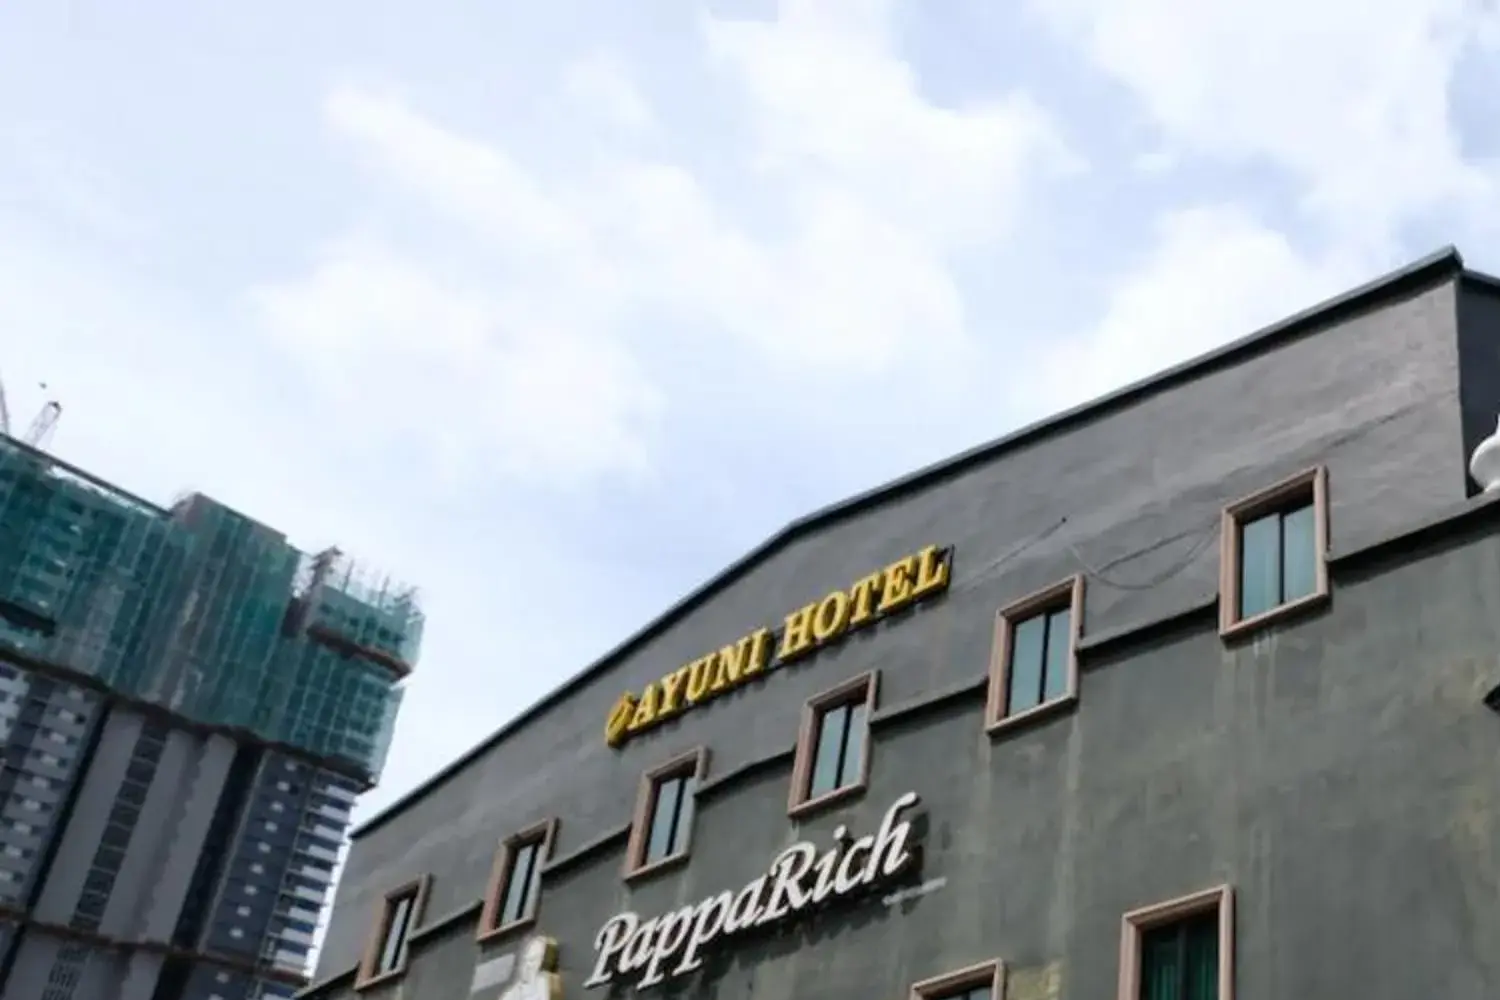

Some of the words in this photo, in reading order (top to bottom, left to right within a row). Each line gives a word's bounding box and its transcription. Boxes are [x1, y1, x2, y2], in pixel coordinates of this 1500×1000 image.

[627, 627, 774, 732] AYUNI
[776, 545, 950, 662] HOTEL
[584, 790, 923, 991] PappaRich
